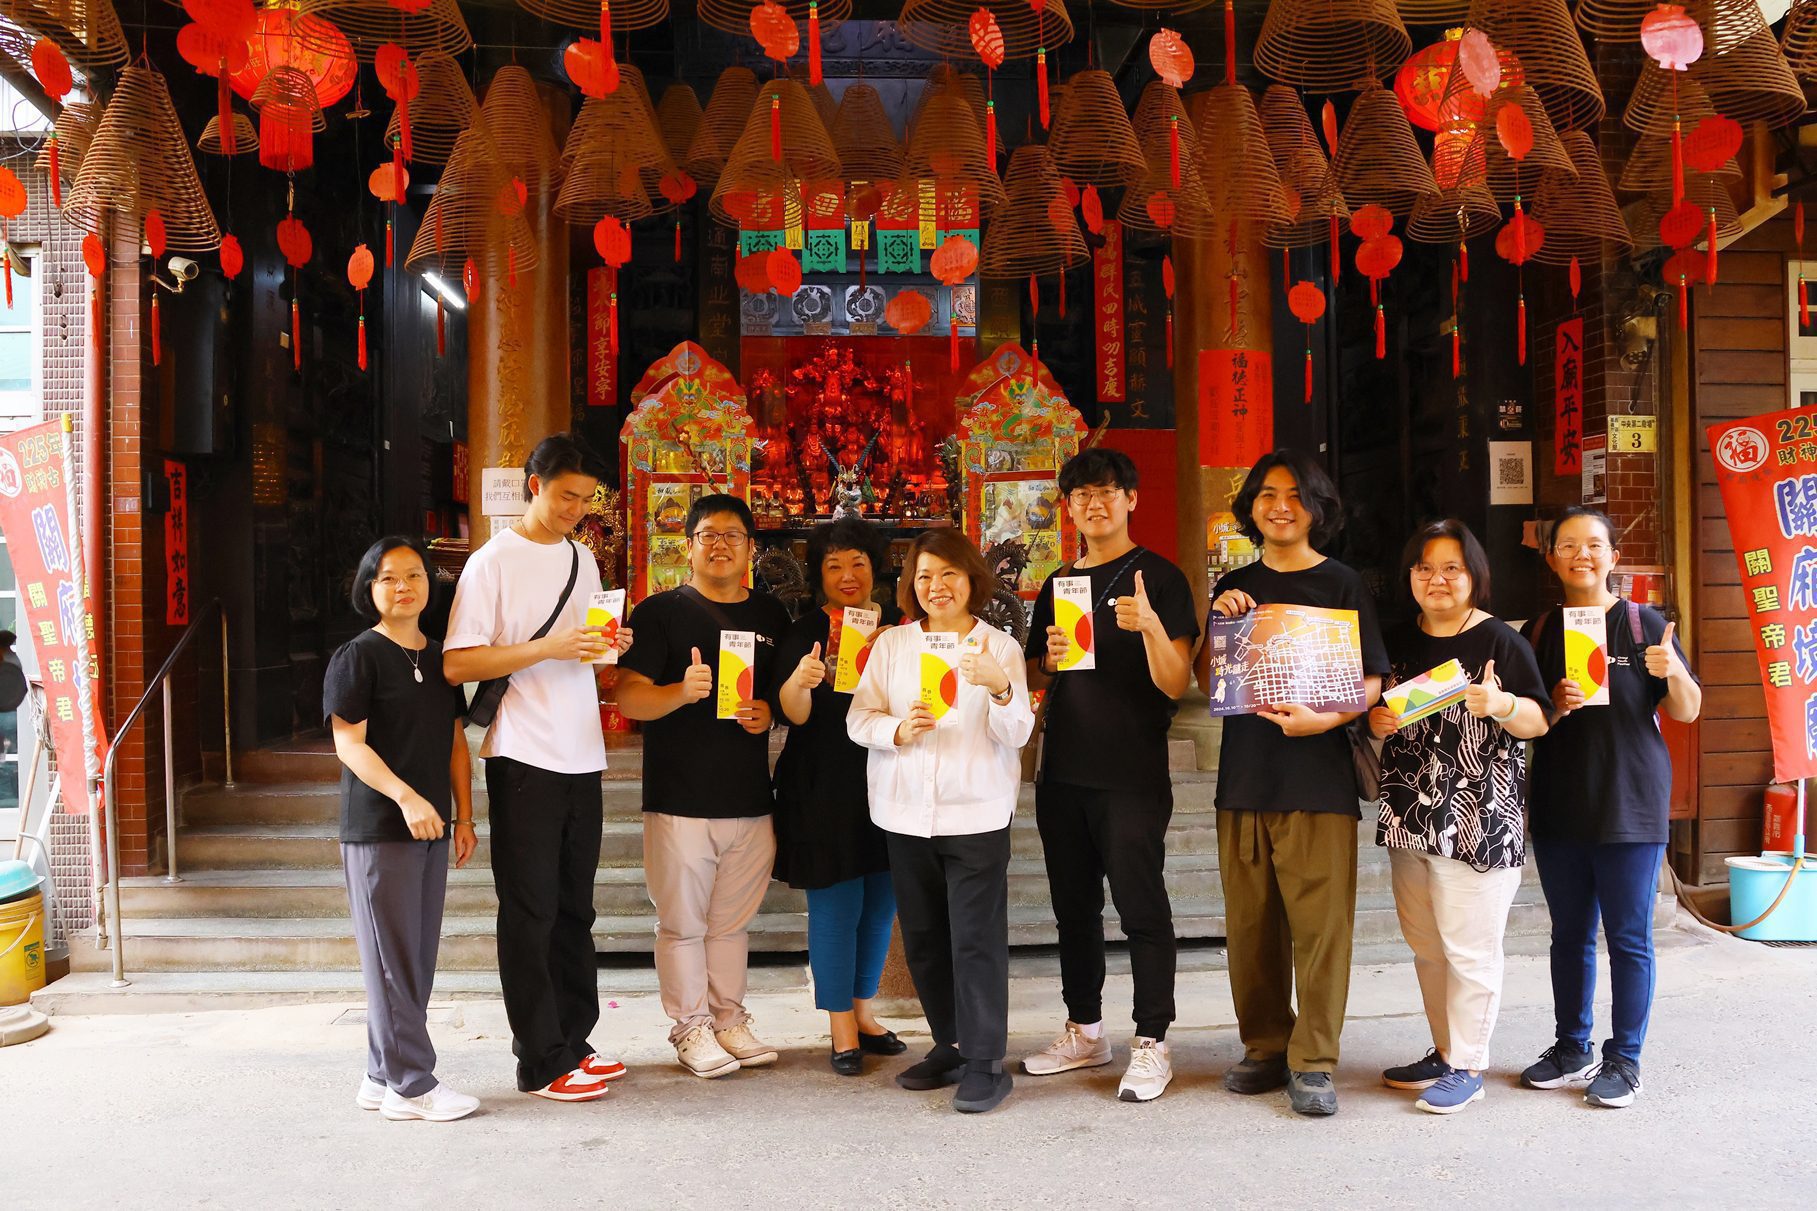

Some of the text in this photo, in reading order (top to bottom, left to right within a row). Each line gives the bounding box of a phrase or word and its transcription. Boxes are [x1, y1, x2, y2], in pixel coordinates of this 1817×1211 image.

[1231, 352, 1249, 421] 福德正神
[1560, 331, 1580, 466] 入廟平安
[1631, 432, 1642, 449] 3
[1724, 431, 1759, 467] 福
[24, 466, 66, 493] 財神古
[170, 468, 186, 618] 吉祥如意
[1058, 580, 1074, 588] 有事
[1063, 587, 1088, 595] 青年節
[851, 617, 875, 627] 青年節
[1569, 610, 1586, 618] 有事
[1574, 617, 1602, 626] 青年節
[1743, 548, 1793, 689] 關聖帝君
[925, 635, 941, 643] 有事
[930, 642, 955, 650] 青年節
[27, 581, 74, 723] 關聖帝君
